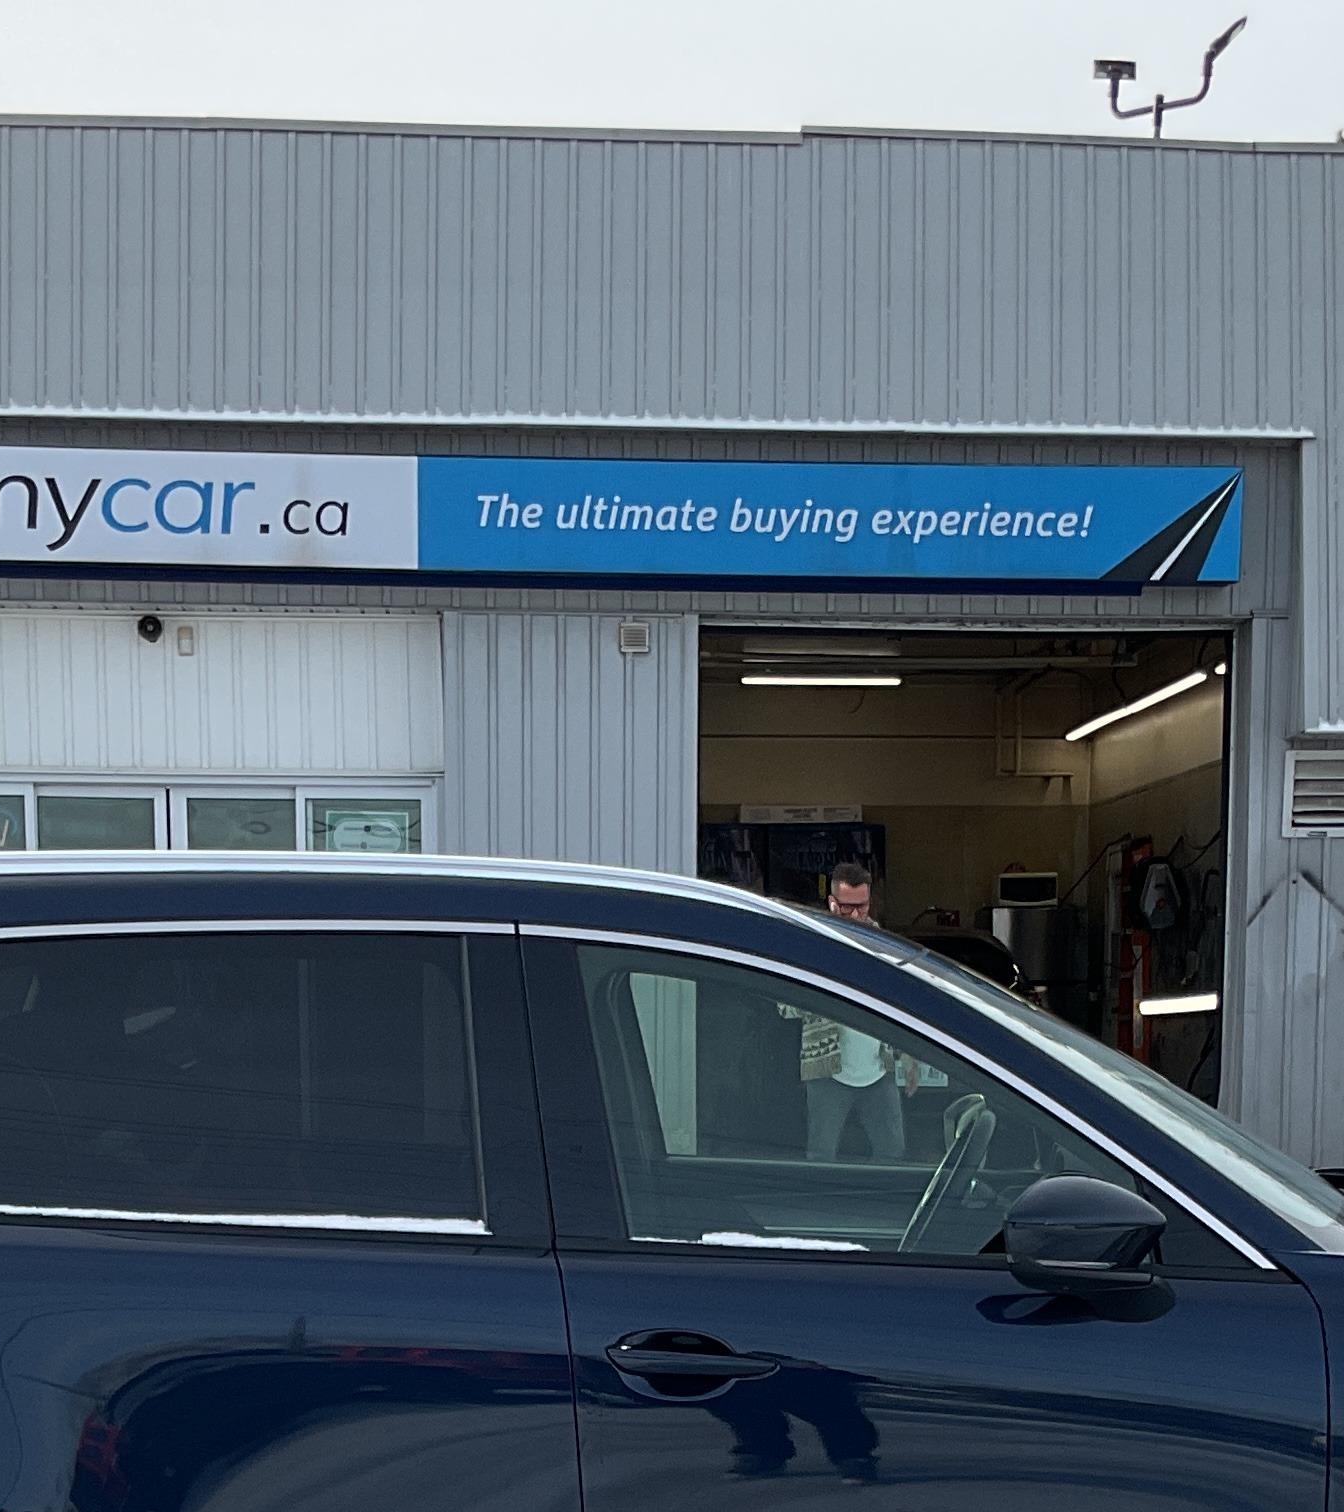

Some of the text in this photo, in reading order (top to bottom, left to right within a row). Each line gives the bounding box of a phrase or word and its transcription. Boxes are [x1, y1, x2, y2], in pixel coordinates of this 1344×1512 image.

[477, 492, 1094, 545] The ultimate buying experience!
